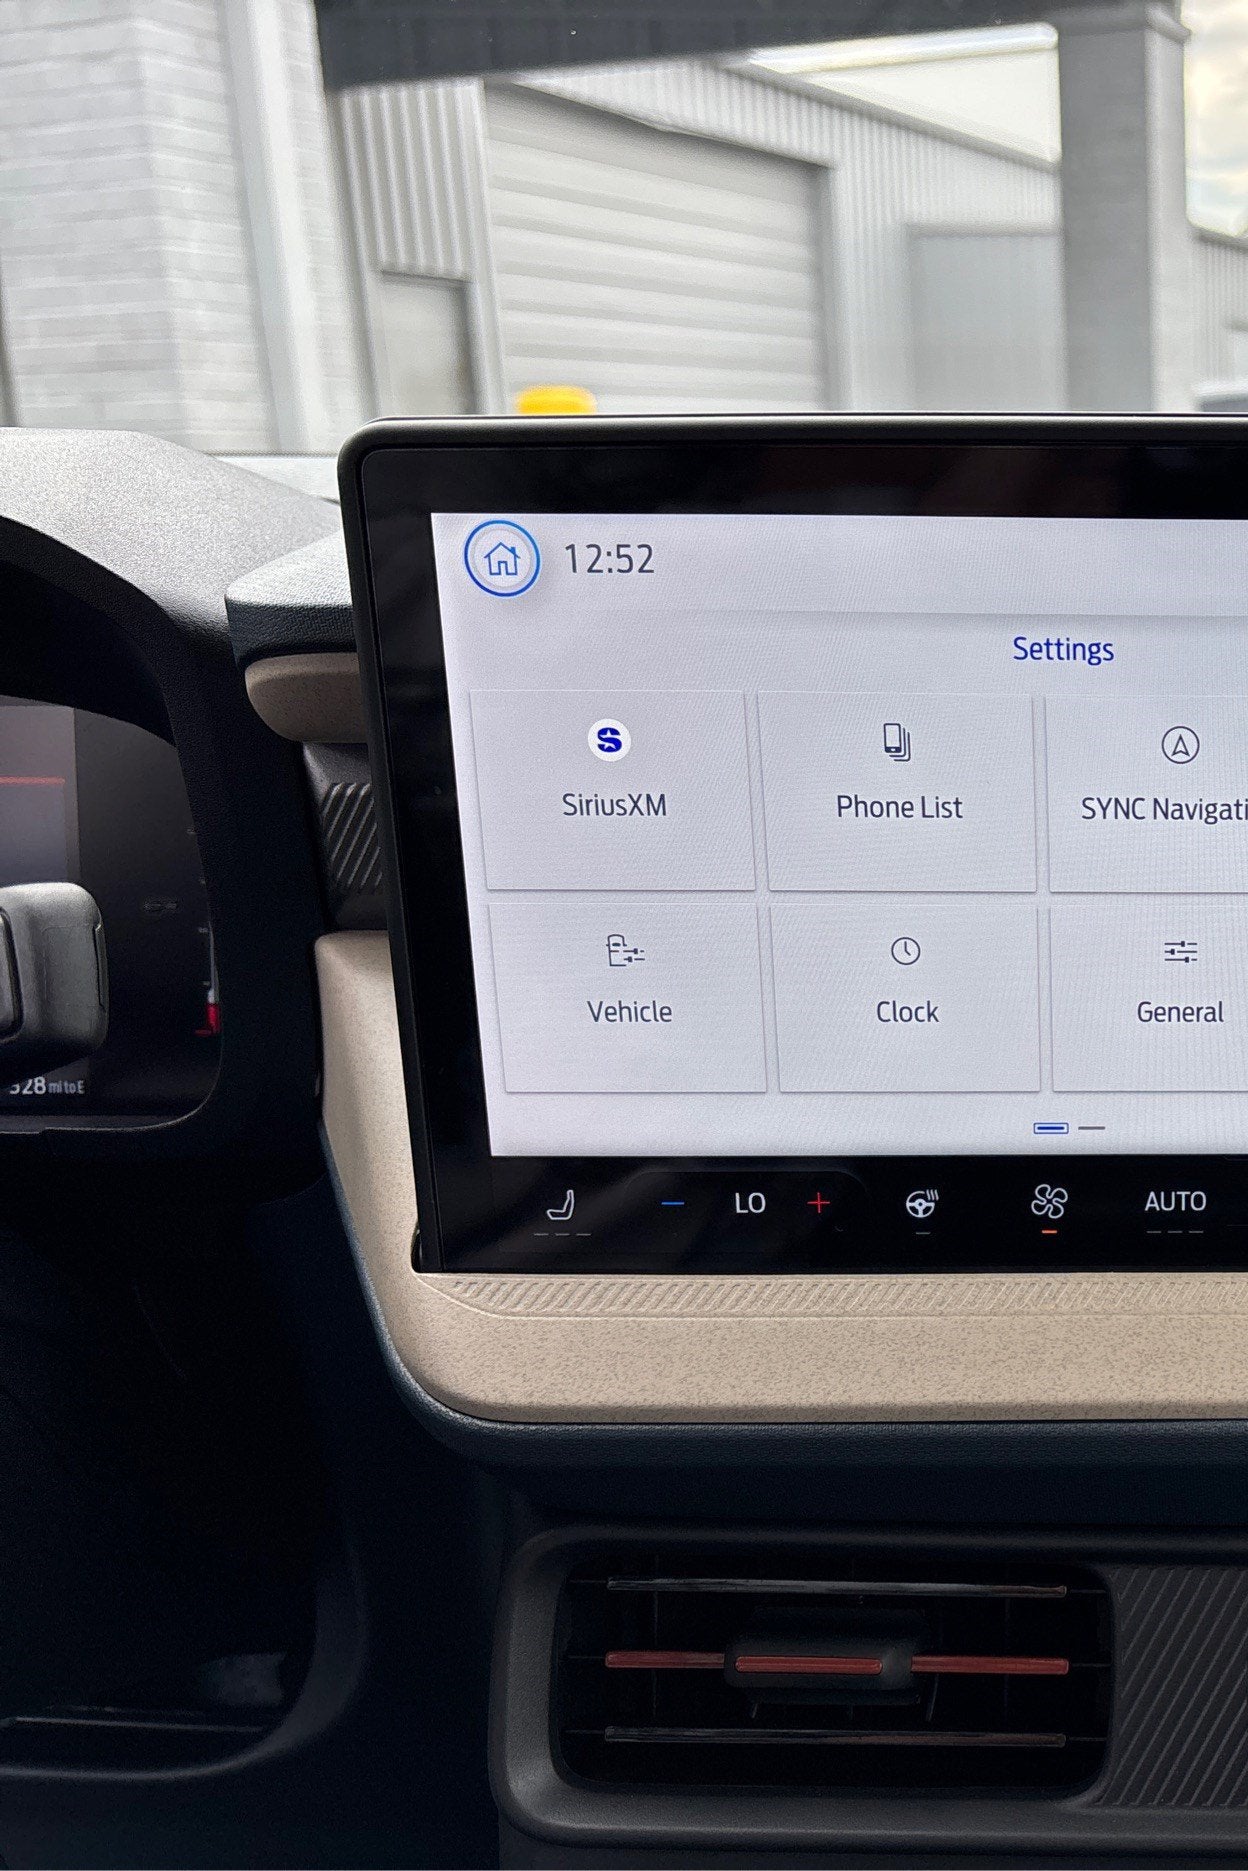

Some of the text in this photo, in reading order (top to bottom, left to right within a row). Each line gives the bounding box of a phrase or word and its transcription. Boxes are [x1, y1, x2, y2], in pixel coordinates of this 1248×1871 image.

[564, 543, 656, 575] 12:52
[1012, 635, 1115, 666] Settings
[561, 792, 668, 817] SiriusXM
[836, 794, 964, 819] Phone List
[1081, 796, 1147, 822] SYNC
[585, 1000, 674, 1024] Vehicle
[875, 1000, 940, 1024] Clock
[1136, 1000, 1225, 1024] General
[734, 1192, 767, 1215] LO
[1144, 1190, 1208, 1213] AUTO
